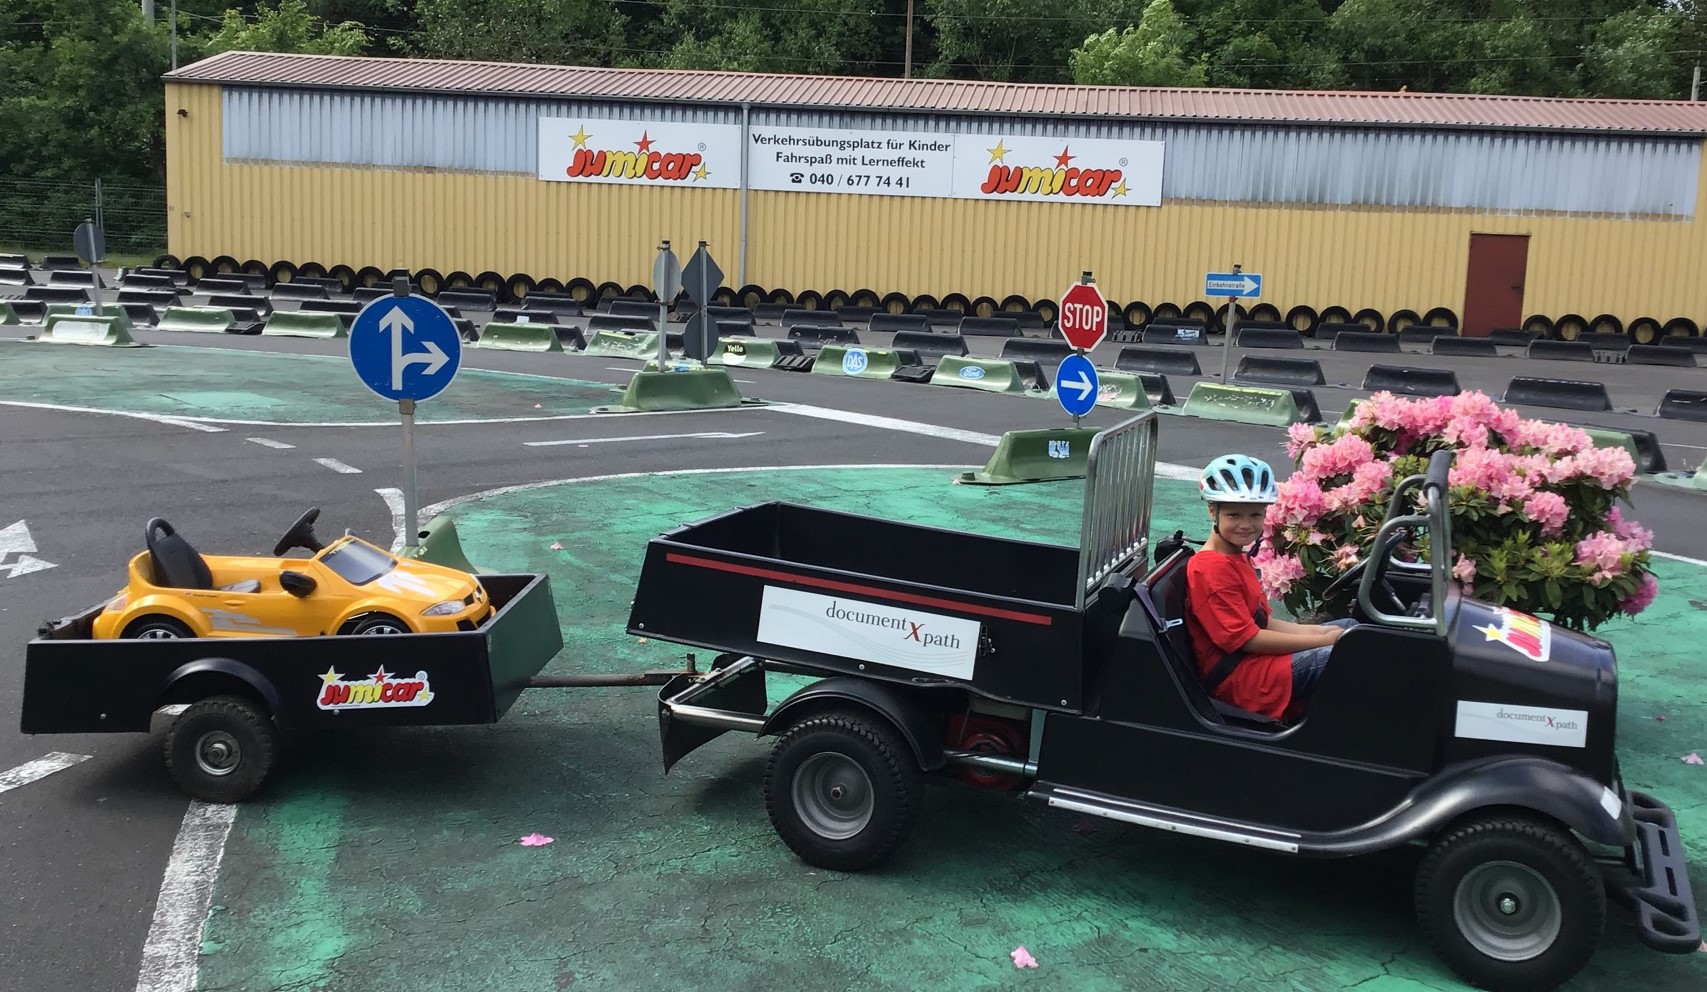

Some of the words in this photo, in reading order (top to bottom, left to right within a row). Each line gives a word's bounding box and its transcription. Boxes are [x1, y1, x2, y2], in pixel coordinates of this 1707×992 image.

[752, 133, 883, 151] Verkehrsübungsplatz
[886, 138, 905, 150] für
[908, 139, 951, 152] Kinder
[775, 151, 833, 166] Fahrspaß
[836, 154, 858, 166] mit
[861, 155, 926, 169] Lerneffekt
[809, 173, 834, 185] 040
[846, 174, 871, 187] 677
[875, 175, 891, 187] 74
[895, 176, 910, 188] 41
[1208, 281, 1245, 289] Einbahnstraße
[1063, 302, 1103, 332] STOP
[727, 344, 744, 353] Yello
[963, 368, 981, 377] Ford
